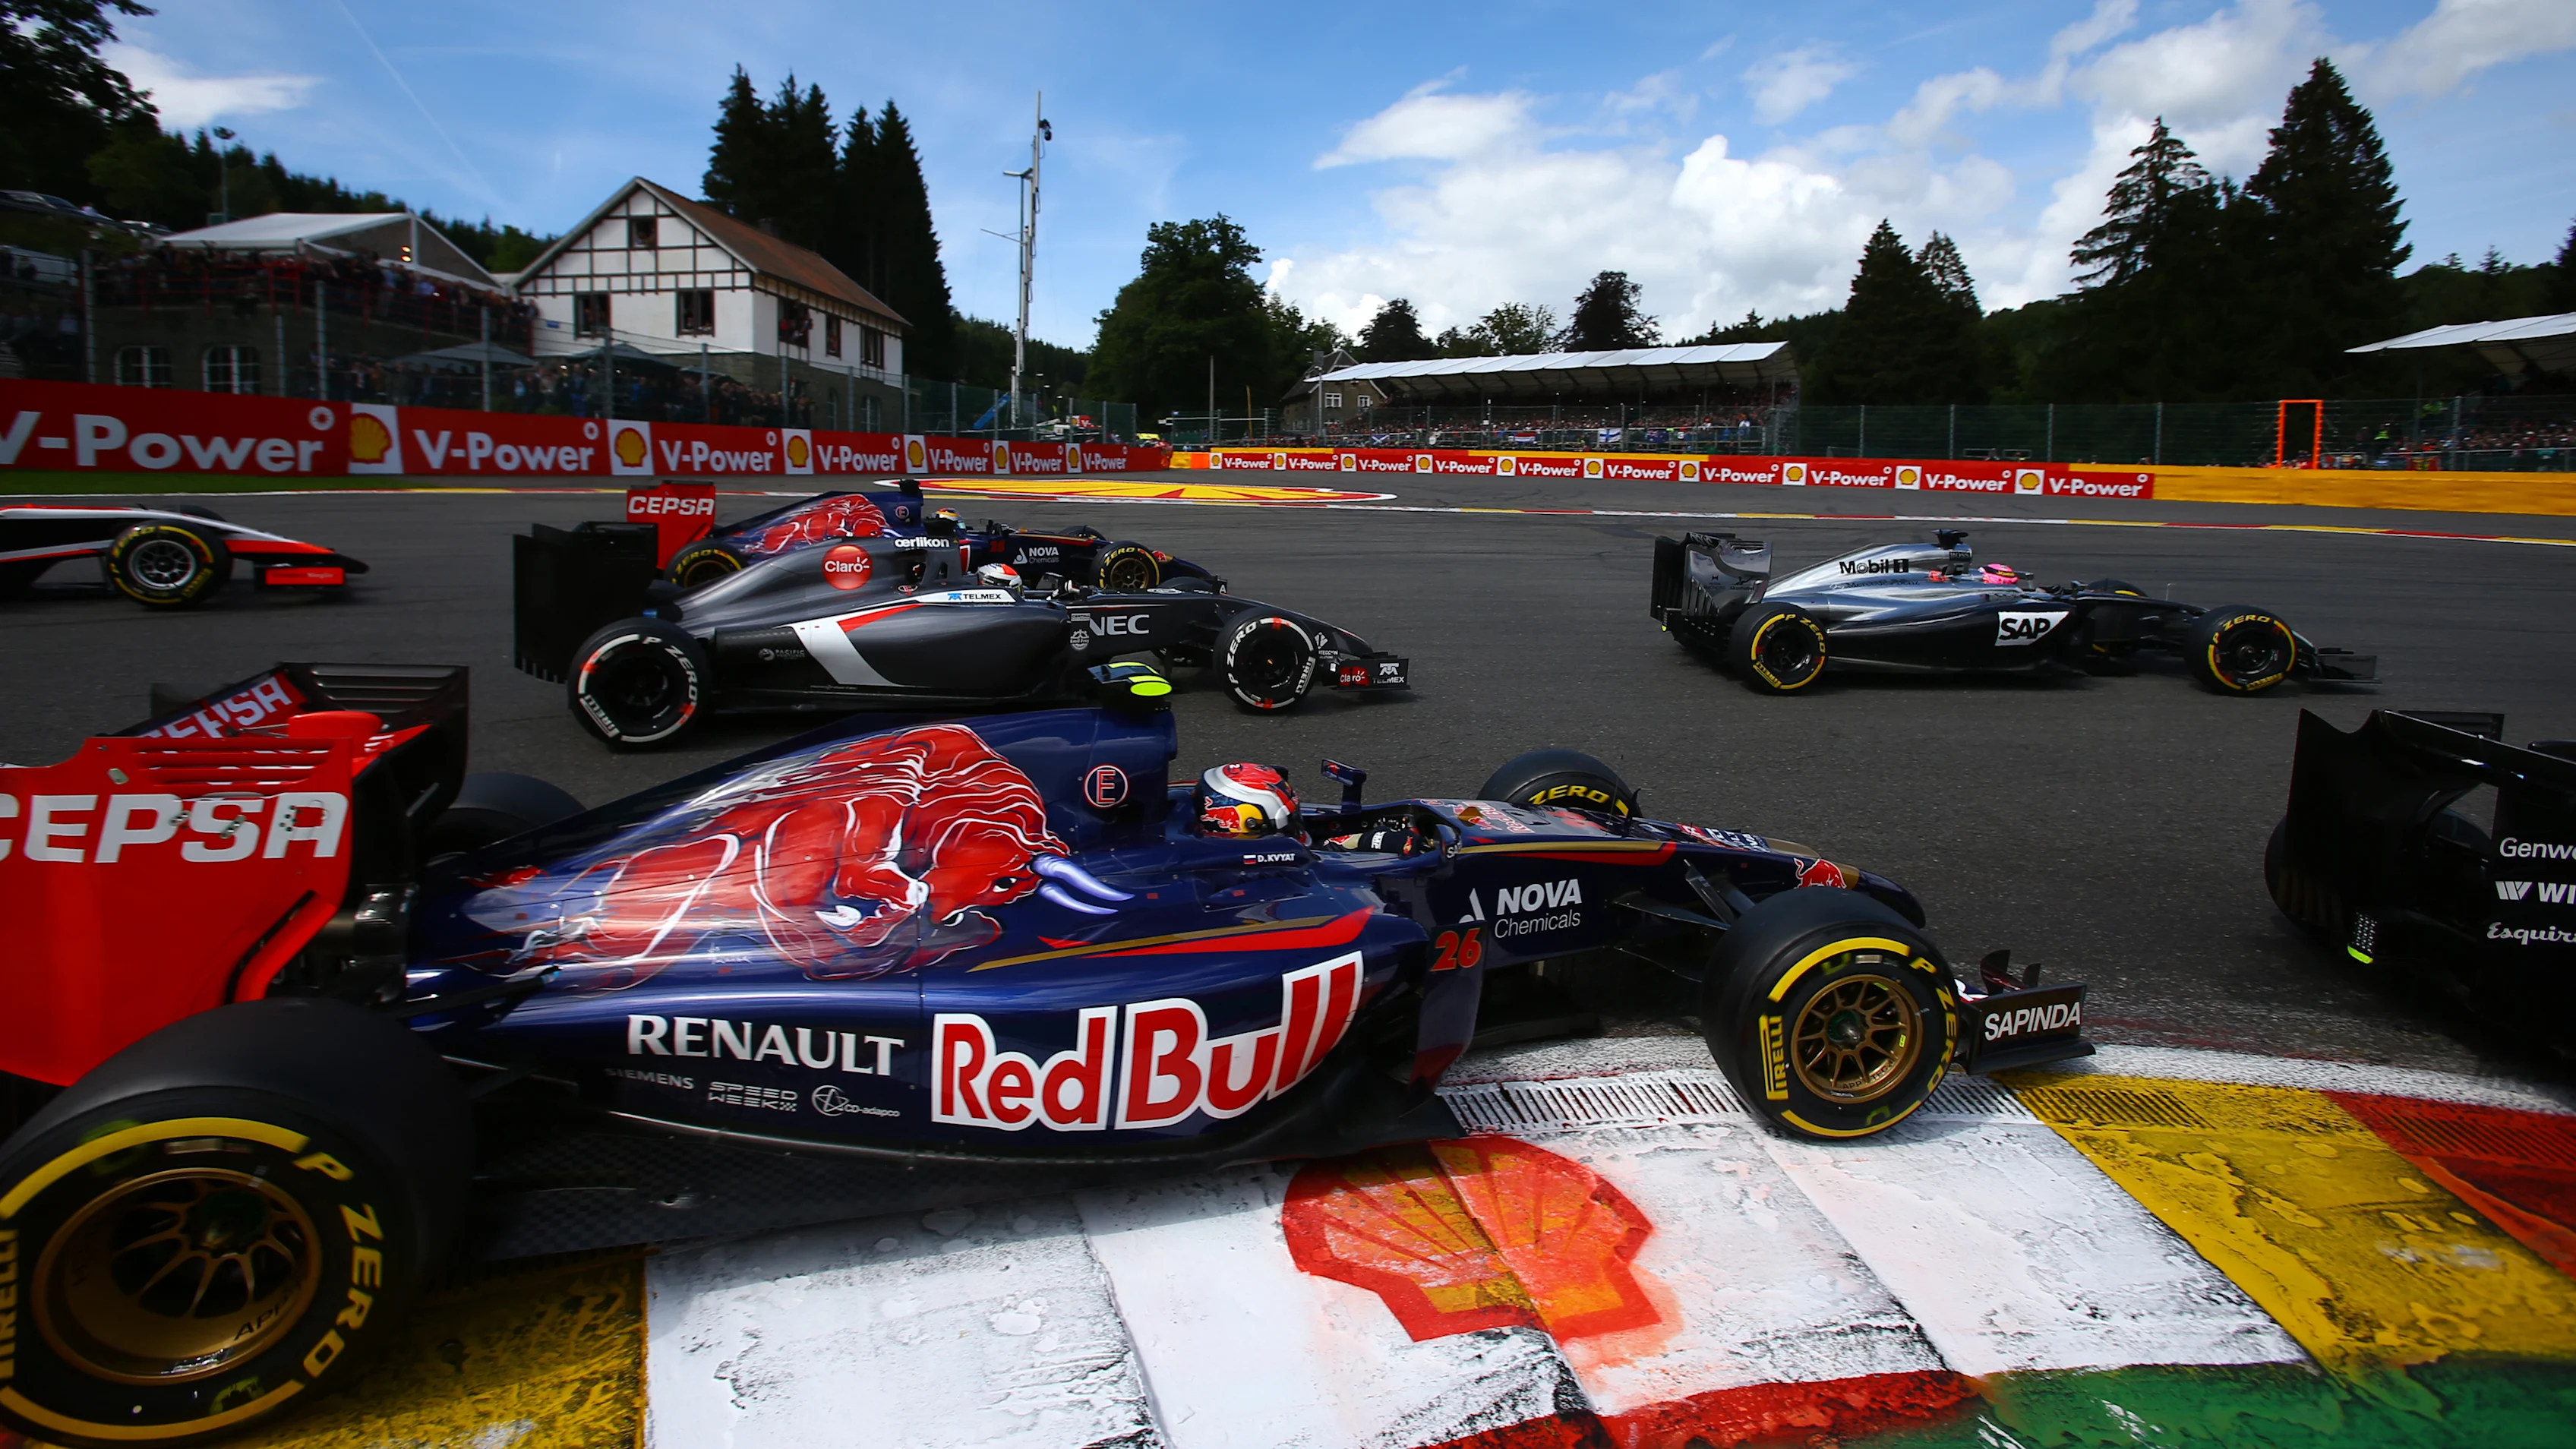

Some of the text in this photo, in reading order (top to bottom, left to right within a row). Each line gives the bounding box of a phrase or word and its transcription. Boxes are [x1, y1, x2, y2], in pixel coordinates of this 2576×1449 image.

[413, 430, 595, 472] V-Power
[659, 440, 773, 472] V-Power
[817, 444, 898, 472] V-Power
[929, 448, 987, 472] V-Power
[1083, 453, 1126, 470] V-Power
[1012, 452, 1062, 472] V-Power
[1224, 457, 1271, 469] V-Power
[1290, 459, 1337, 471] V-Power
[1359, 459, 1410, 472] V-Power
[1435, 460, 1493, 474] V-Power
[1519, 462, 1577, 477] V-Power
[1607, 465, 1672, 480] V-Power
[1704, 468, 1775, 483] V-Power
[1811, 471, 1887, 486] V-Power
[1926, 474, 2006, 491] V-Power
[2049, 478, 2142, 496] V-Power
[628, 496, 715, 516] CEPSA
[1029, 547, 1059, 557] NOVA
[1104, 547, 1135, 567] ZERO
[825, 560, 866, 573] Claro
[1839, 557, 1889, 574] Mobil
[1089, 614, 1150, 636] NEC
[1799, 617, 1826, 653] ZERO
[1999, 618, 2050, 640] SAP
[2211, 614, 2271, 645] P ZERO
[1226, 621, 1258, 683] P ZERO
[664, 646, 698, 702] ZERO
[1295, 656, 1316, 695] PIRELLI
[1372, 676, 1405, 684] TELMEX
[579, 694, 620, 738] PIRELLI
[1527, 784, 1610, 805] ZERO
[1257, 854, 1296, 863] D.KVYAT
[1494, 879, 1583, 916] NOVA
[1494, 911, 1582, 939] Chemicals
[1430, 927, 1482, 972] 26
[1909, 957, 1957, 1093] P ZERO
[1984, 1001, 2082, 1042] SAPINDA
[627, 1014, 904, 1077] RENAULT
[933, 950, 1364, 1131] Red Bull
[1758, 1014, 1789, 1101] PIRELLI
[605, 1068, 694, 1090] SIEMENS
[708, 1092, 779, 1110] WEEK
[709, 1081, 798, 1100] SPEED
[844, 1104, 901, 1118] CD-adapco
[292, 1151, 384, 1378] P ZERO
